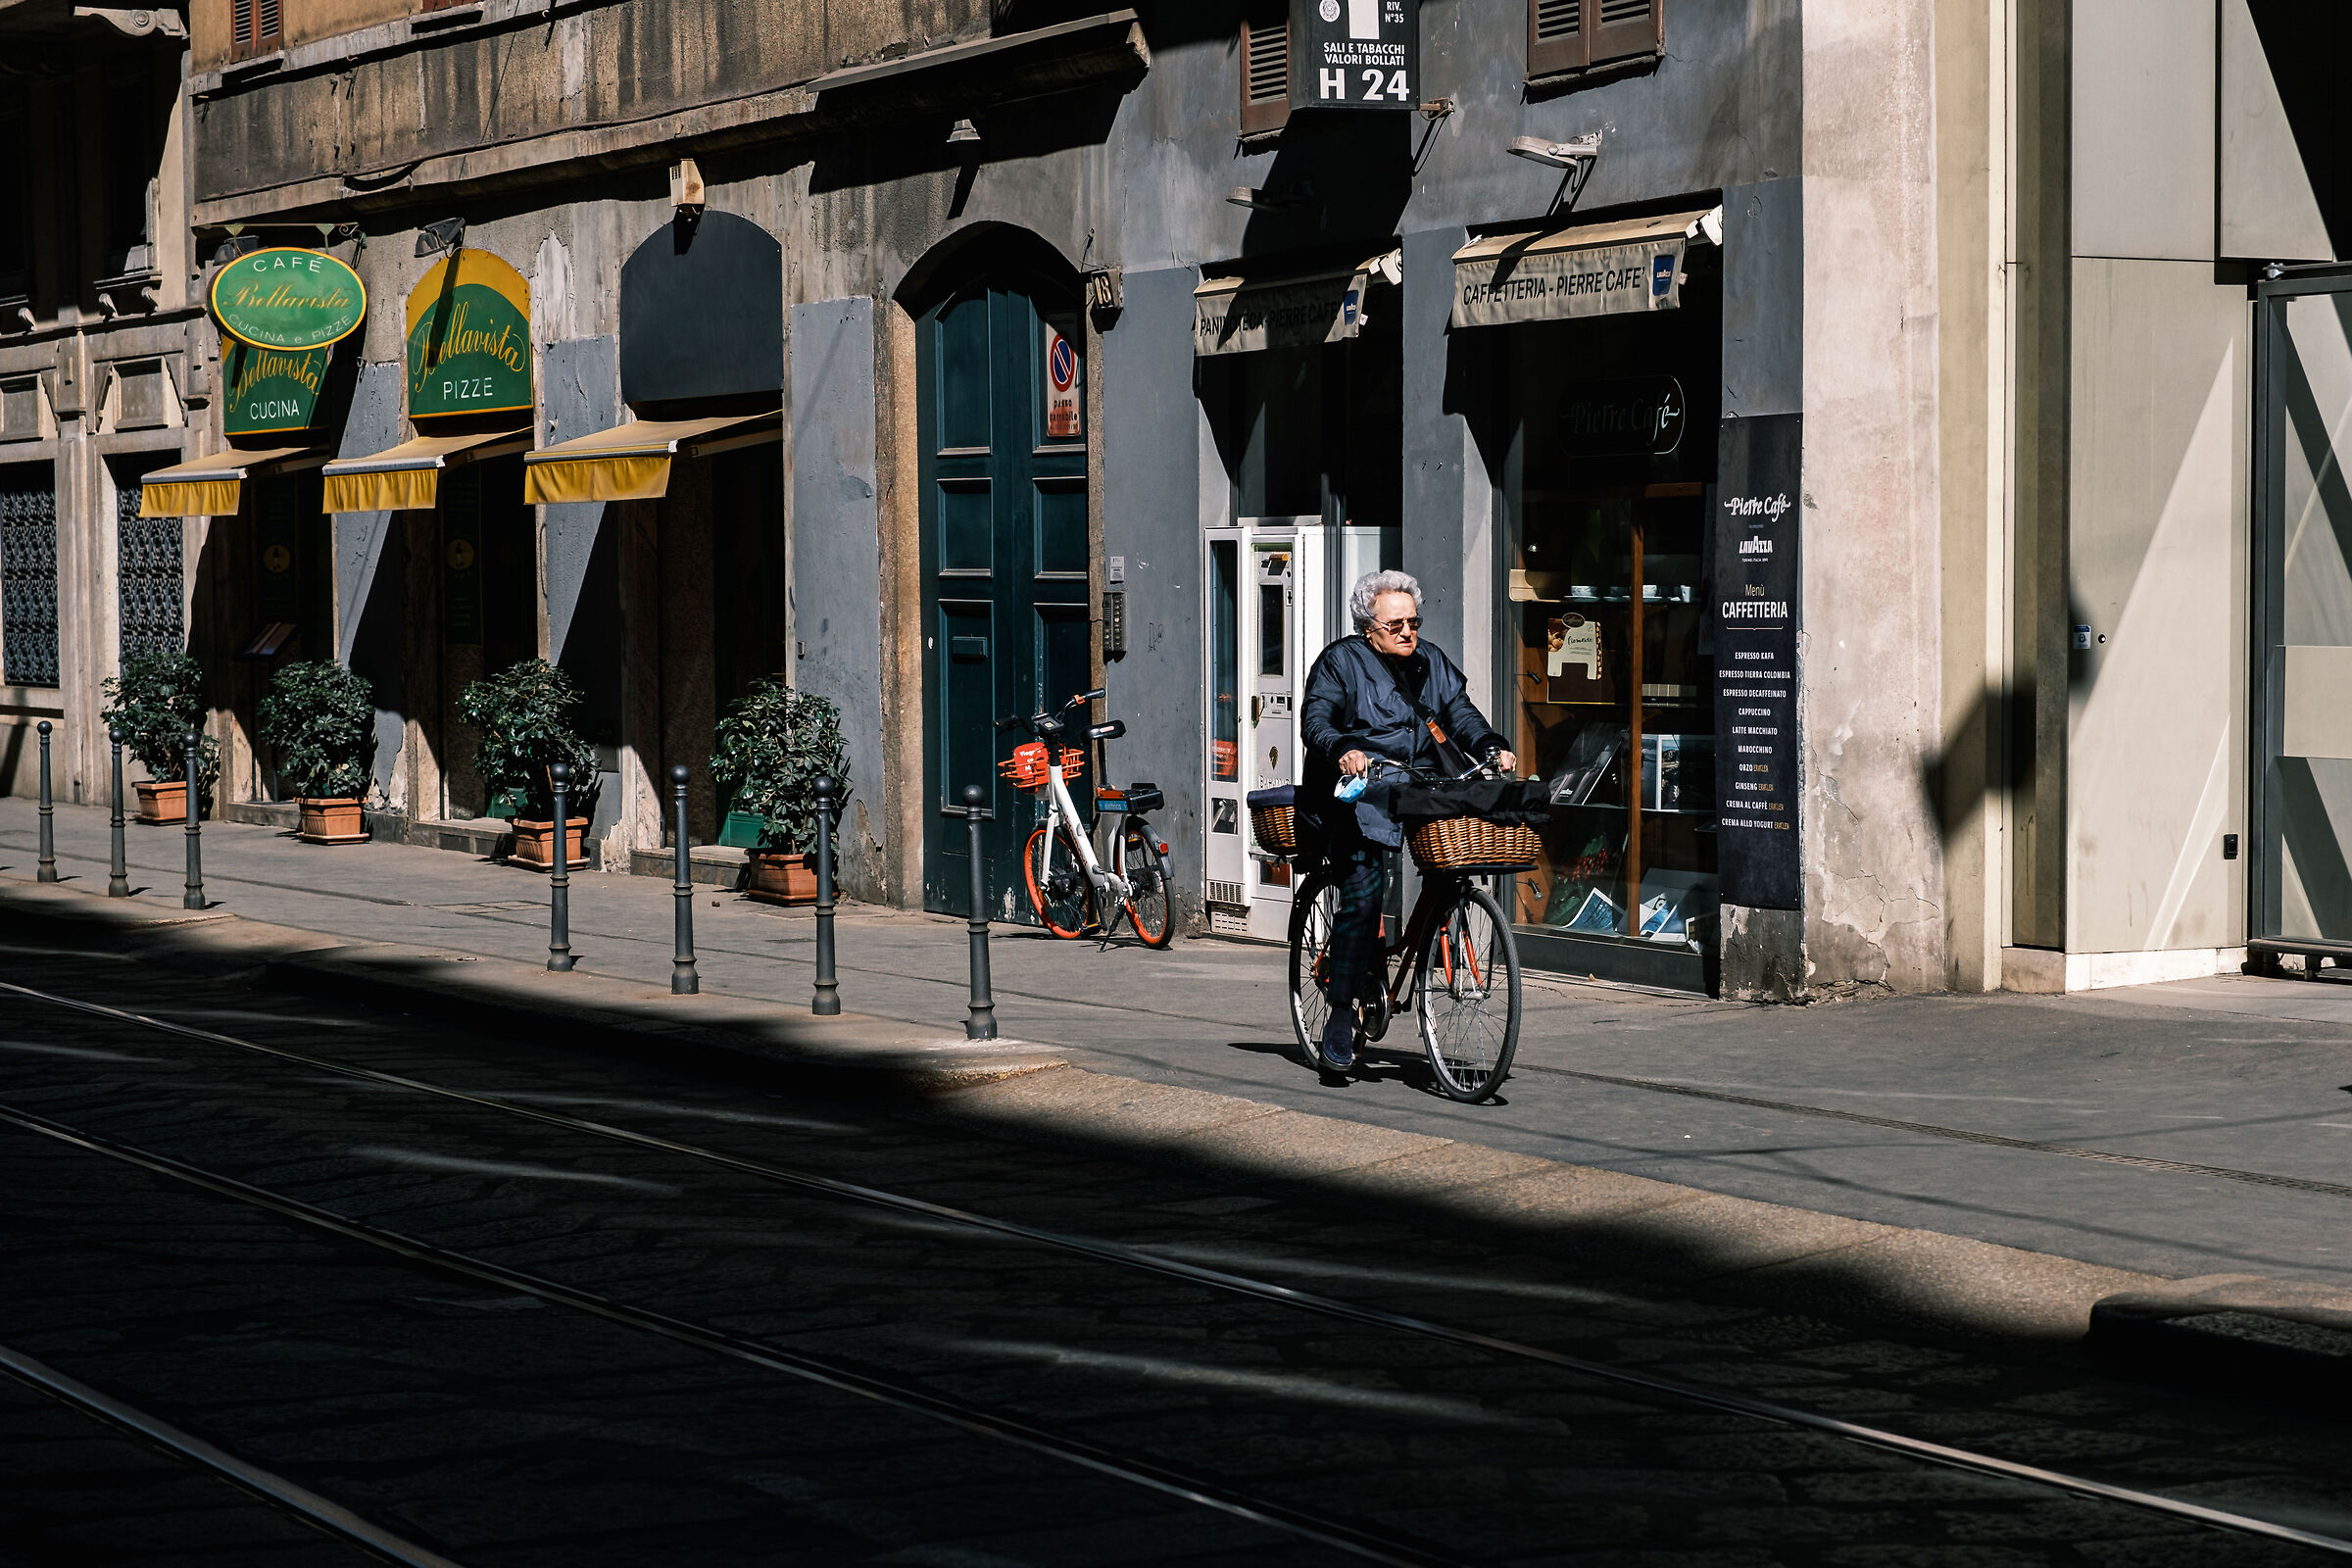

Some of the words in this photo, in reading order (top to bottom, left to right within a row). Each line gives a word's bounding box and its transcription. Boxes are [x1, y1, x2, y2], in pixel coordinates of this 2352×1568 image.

[1387, 1, 1401, 11] RIV.
[1385, 13, 1404, 24] N°35
[1323, 42, 1346, 53] SALI
[1348, 42, 1354, 53] E
[1356, 43, 1405, 55] TABACCHI
[1324, 53, 1362, 65] VALORI
[1365, 55, 1404, 66] BOLLATI
[1319, 68, 1346, 100] H
[1361, 69, 1410, 101] 24
[253, 257, 324, 273] CAFÉ
[223, 277, 355, 310] Bellavista
[1095, 276, 1112, 304] 18
[1463, 277, 1546, 306] CAFFETTERIA
[1556, 271, 1603, 298] PIERRE
[228, 314, 285, 343] CUCINA
[312, 315, 353, 341] PIZZE
[1199, 311, 1265, 337] PANINOTECA
[1268, 306, 1307, 327] PIERRE
[413, 301, 526, 393] Bellavista
[227, 349, 325, 414] Bellavista
[443, 377, 493, 400] PIZZE
[250, 399, 300, 419] CUCINA
[1725, 496, 1763, 515] Pierre
[1764, 493, 1791, 522] Café
[1739, 535, 1773, 554] LAVAZZA
[1745, 584, 1765, 597] Menù
[1722, 601, 1788, 618] CAFFETTERIA
[1719, 669, 1744, 678] ESPRESSO
[1744, 670, 1763, 679] TIERRA
[1764, 670, 1790, 679] COLOMBIA
[1723, 688, 1748, 697] ESPRESSO
[1748, 689, 1787, 698] DECAFFEINATO
[1738, 708, 1771, 716] CAPPUCCINO
[1732, 726, 1747, 735] LATTE
[1747, 726, 1778, 736] MACCHIATO
[1738, 745, 1773, 755] MAROCCHINO
[1739, 763, 1753, 772] ORZO
[1735, 781, 1758, 791] GINSENG
[1726, 800, 1744, 808] CREMA
[1744, 801, 1751, 809] AL
[1721, 817, 1740, 827] CREMA
[1740, 818, 1753, 828] ALLO
[1753, 820, 1774, 829] YOGURT
